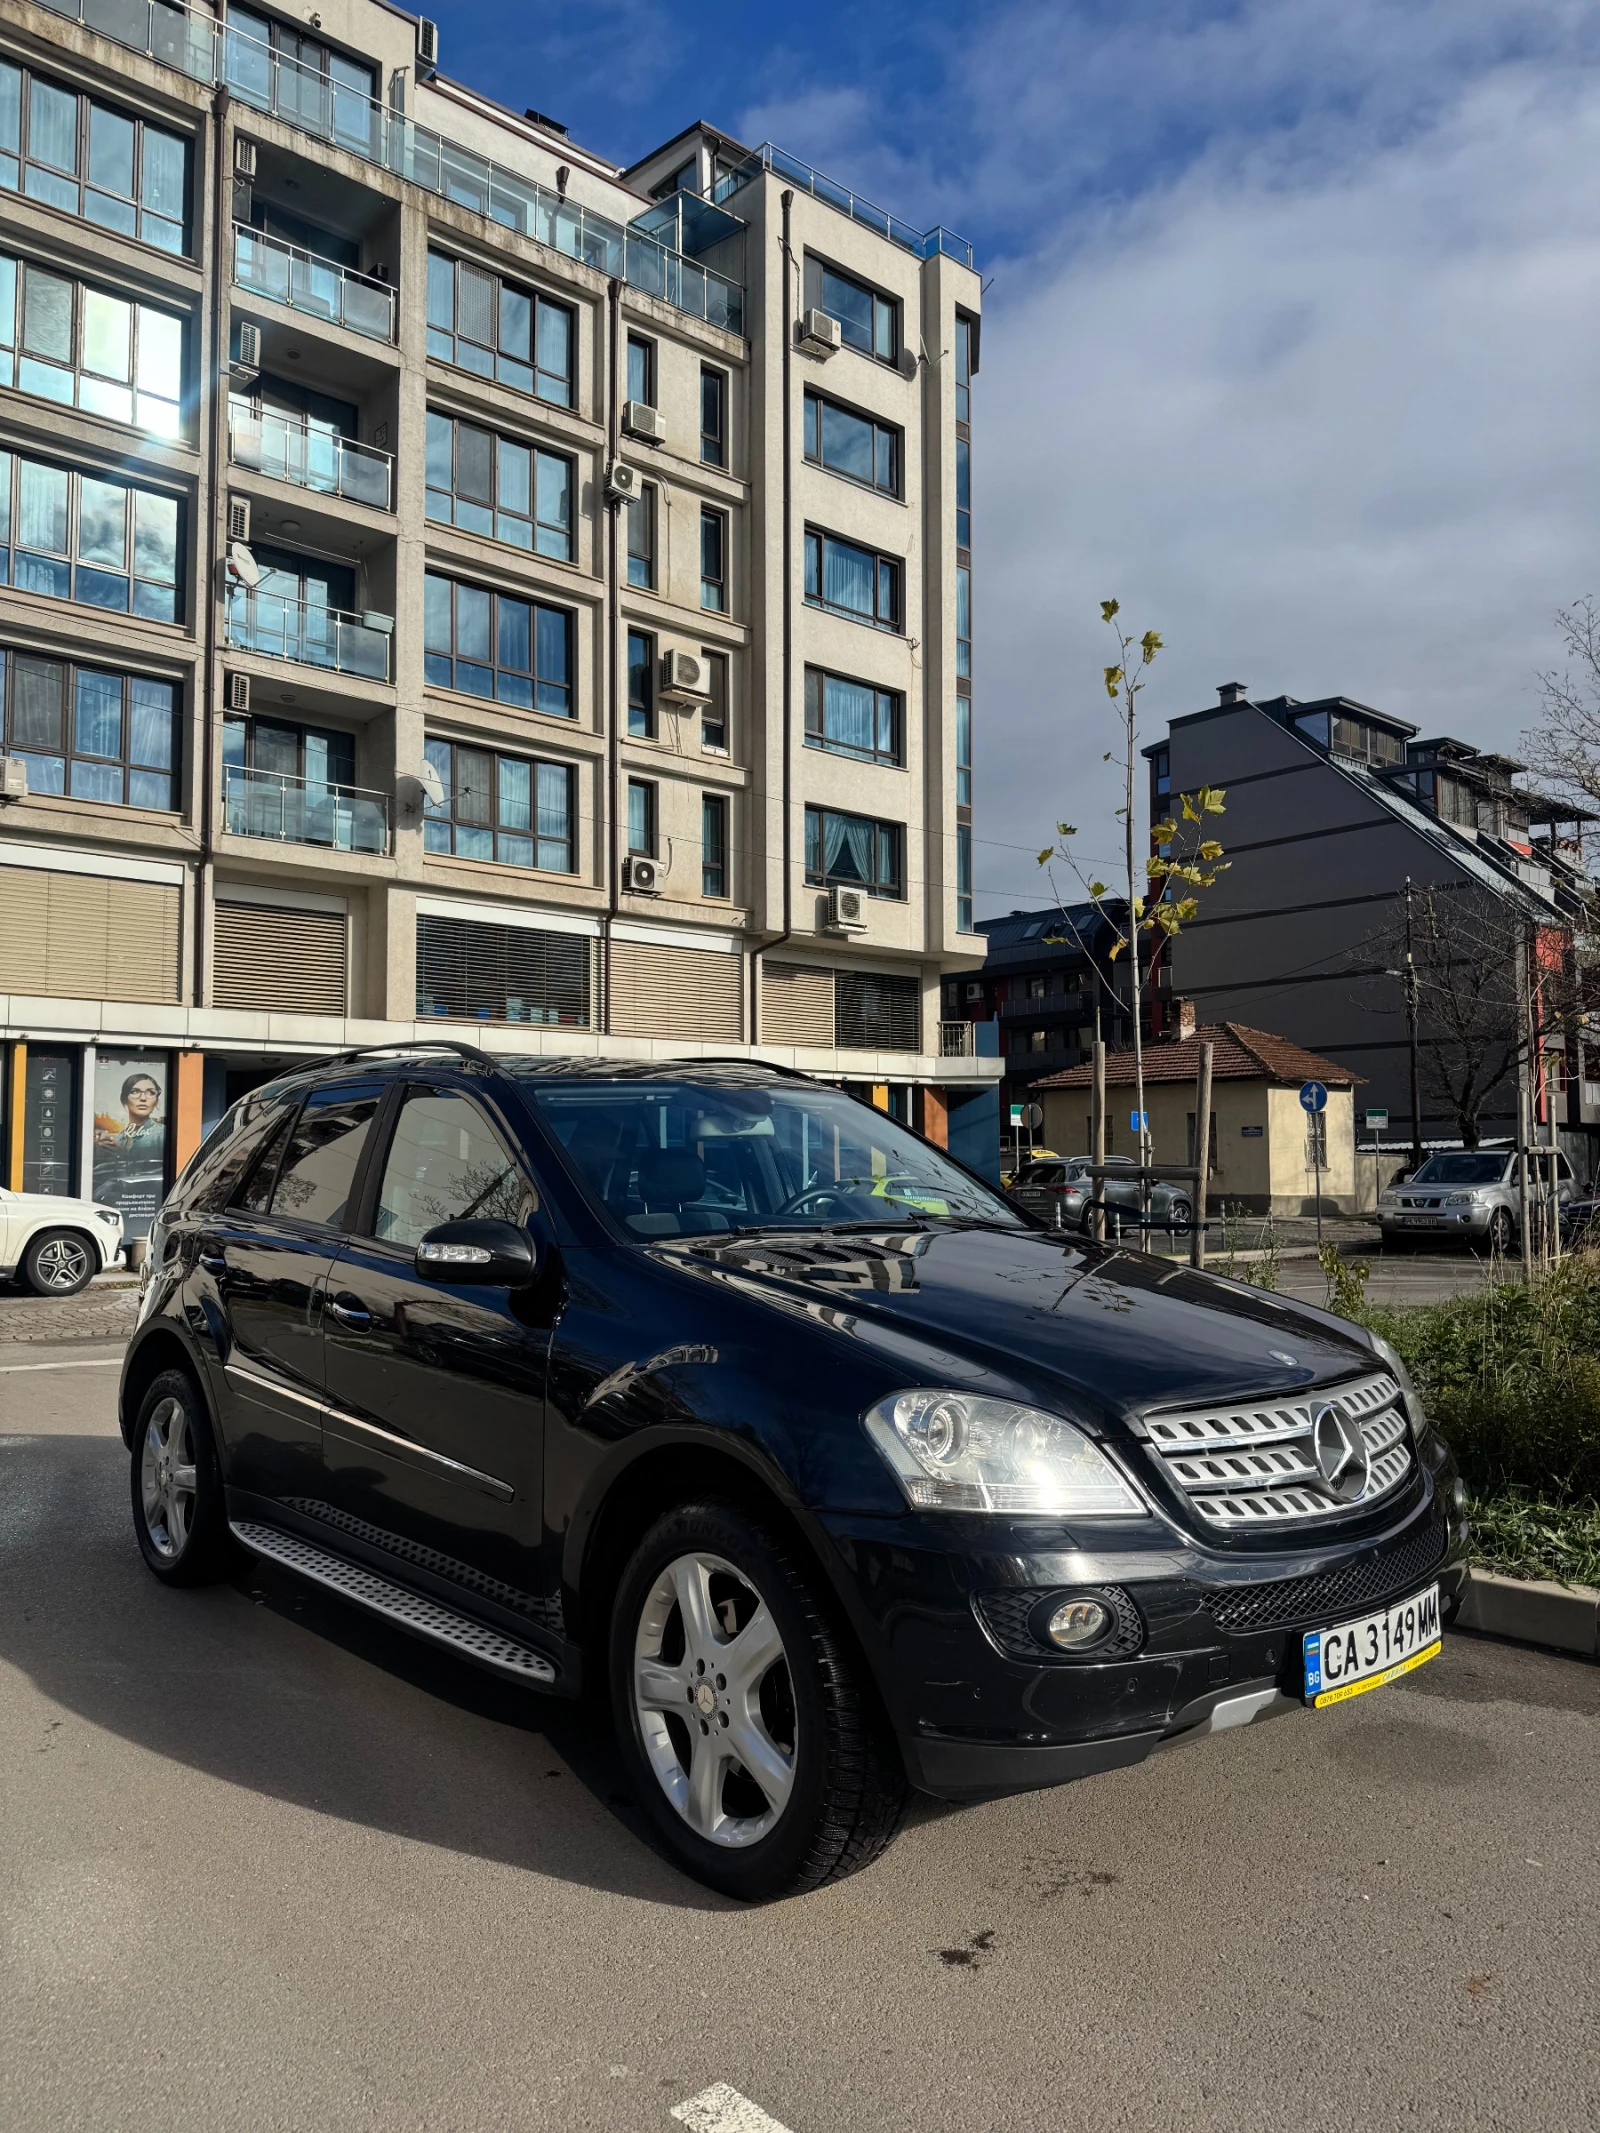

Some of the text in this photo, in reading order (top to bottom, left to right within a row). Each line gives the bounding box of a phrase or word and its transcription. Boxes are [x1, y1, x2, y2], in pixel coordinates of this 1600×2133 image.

[124, 1122, 152, 1138] Relax
[1324, 1591, 1438, 1681] CA 3149 MM
[1308, 1670, 1320, 1686] BG
